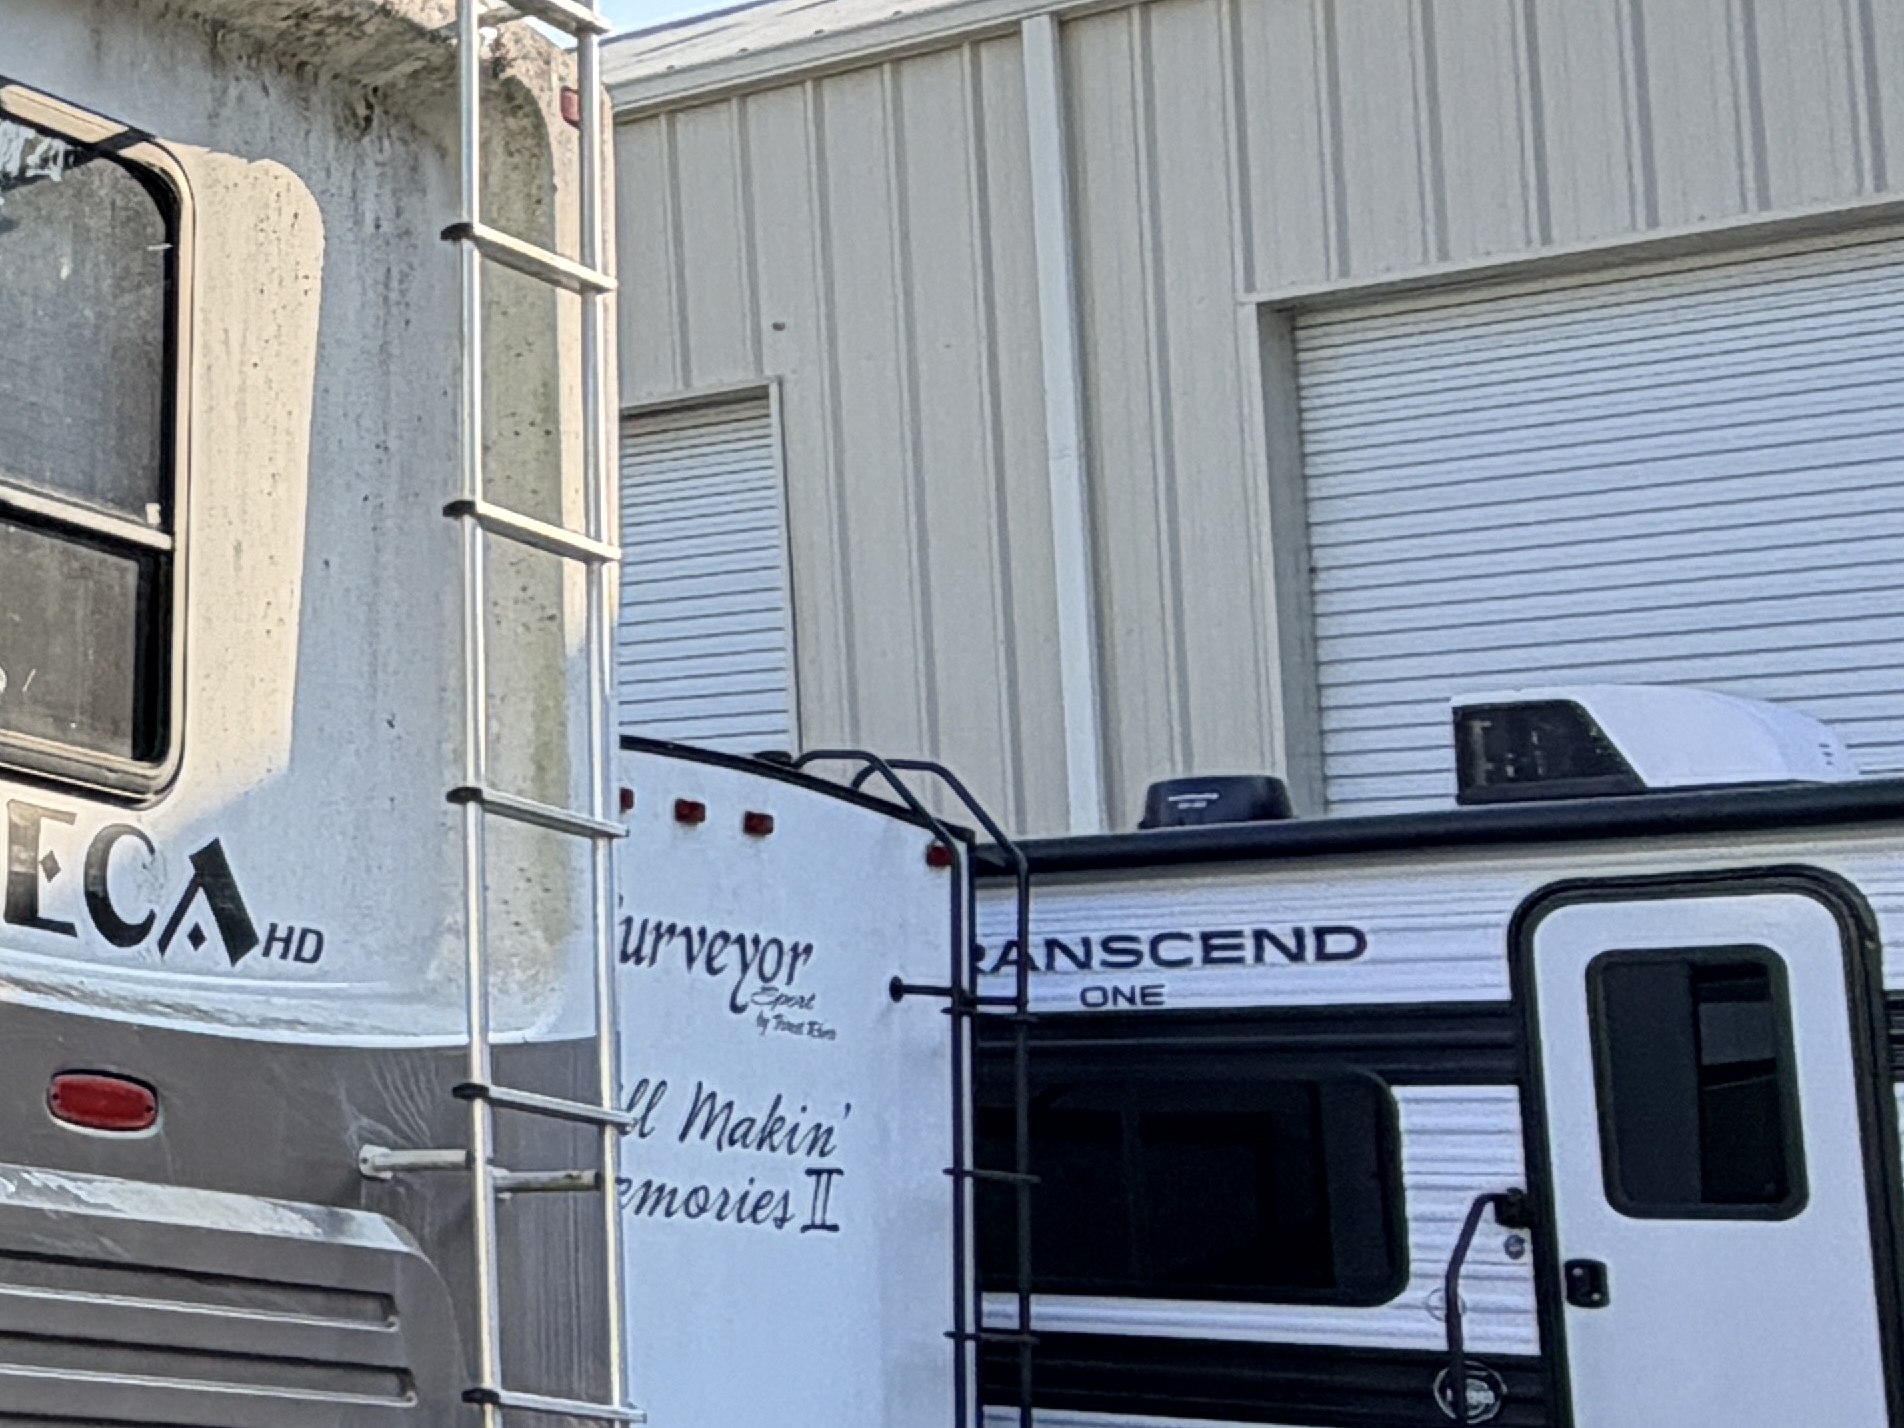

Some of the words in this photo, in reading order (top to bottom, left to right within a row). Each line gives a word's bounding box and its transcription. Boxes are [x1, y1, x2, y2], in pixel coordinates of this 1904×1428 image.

[262, 922, 325, 964] HD
[618, 893, 814, 1014] urveyor
[1080, 984, 1166, 1009] ONE
[678, 1080, 852, 1158] Makin'
[614, 1176, 795, 1230] emories
[800, 1167, 845, 1233] II
